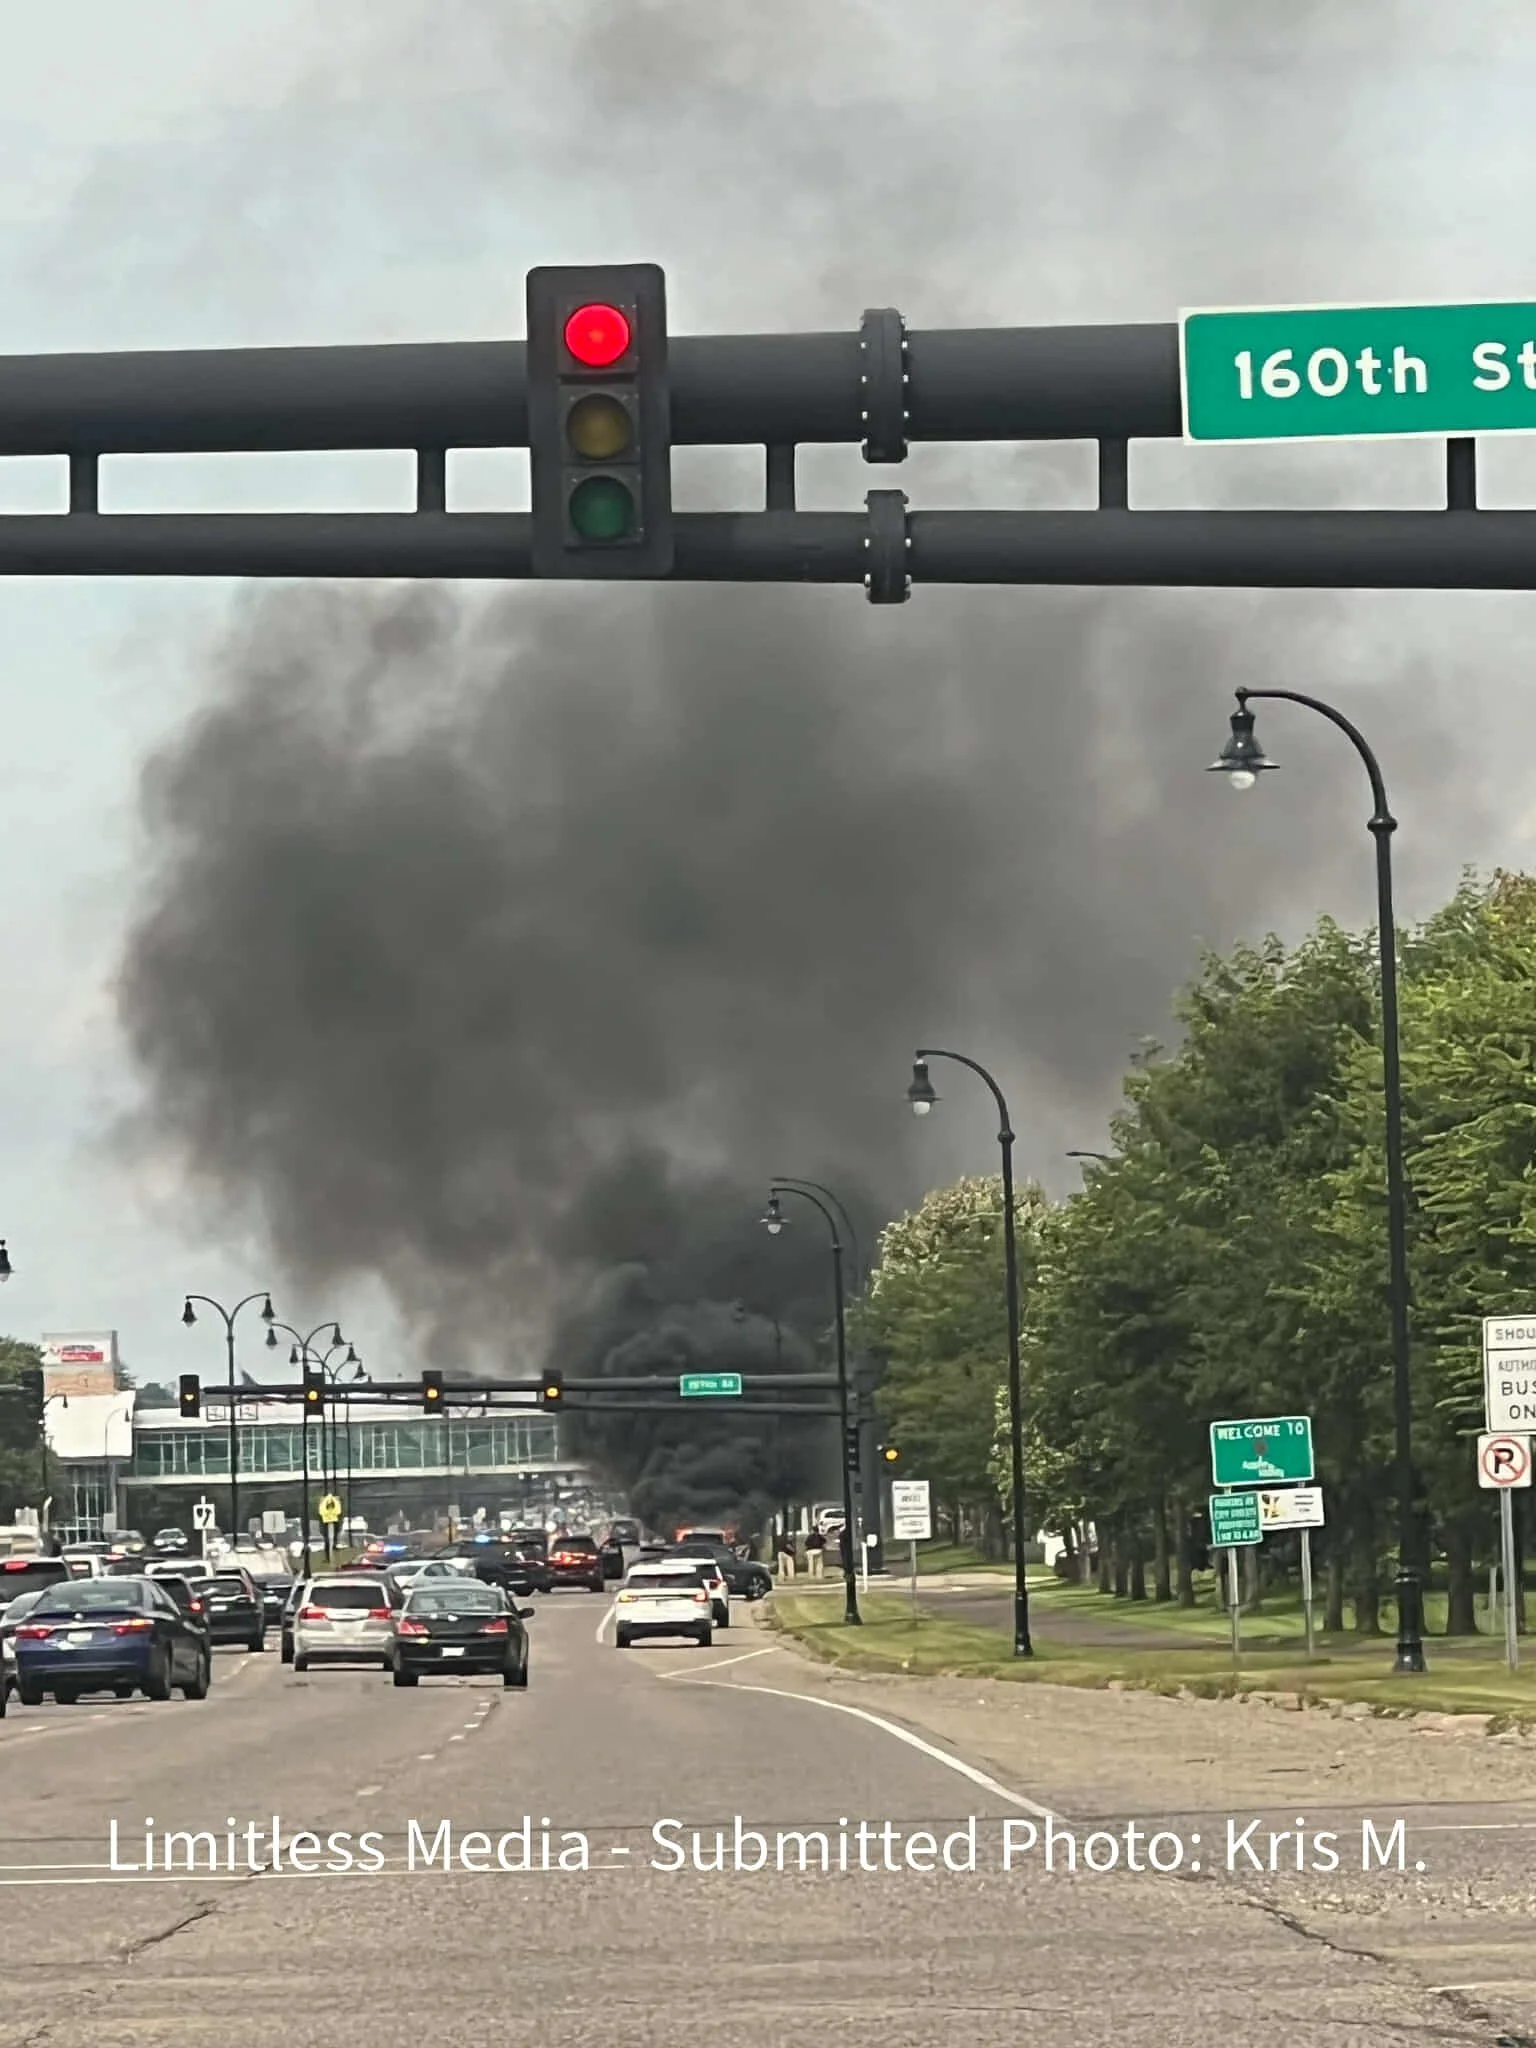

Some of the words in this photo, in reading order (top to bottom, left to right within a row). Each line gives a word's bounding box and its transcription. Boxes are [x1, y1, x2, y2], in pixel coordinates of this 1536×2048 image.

[1234, 346, 1428, 399] 160th
[1472, 341, 1536, 391] St
[1216, 1424, 1281, 1440] WELCOME
[1287, 1422, 1304, 1436] TO
[1494, 1447, 1514, 1474] P
